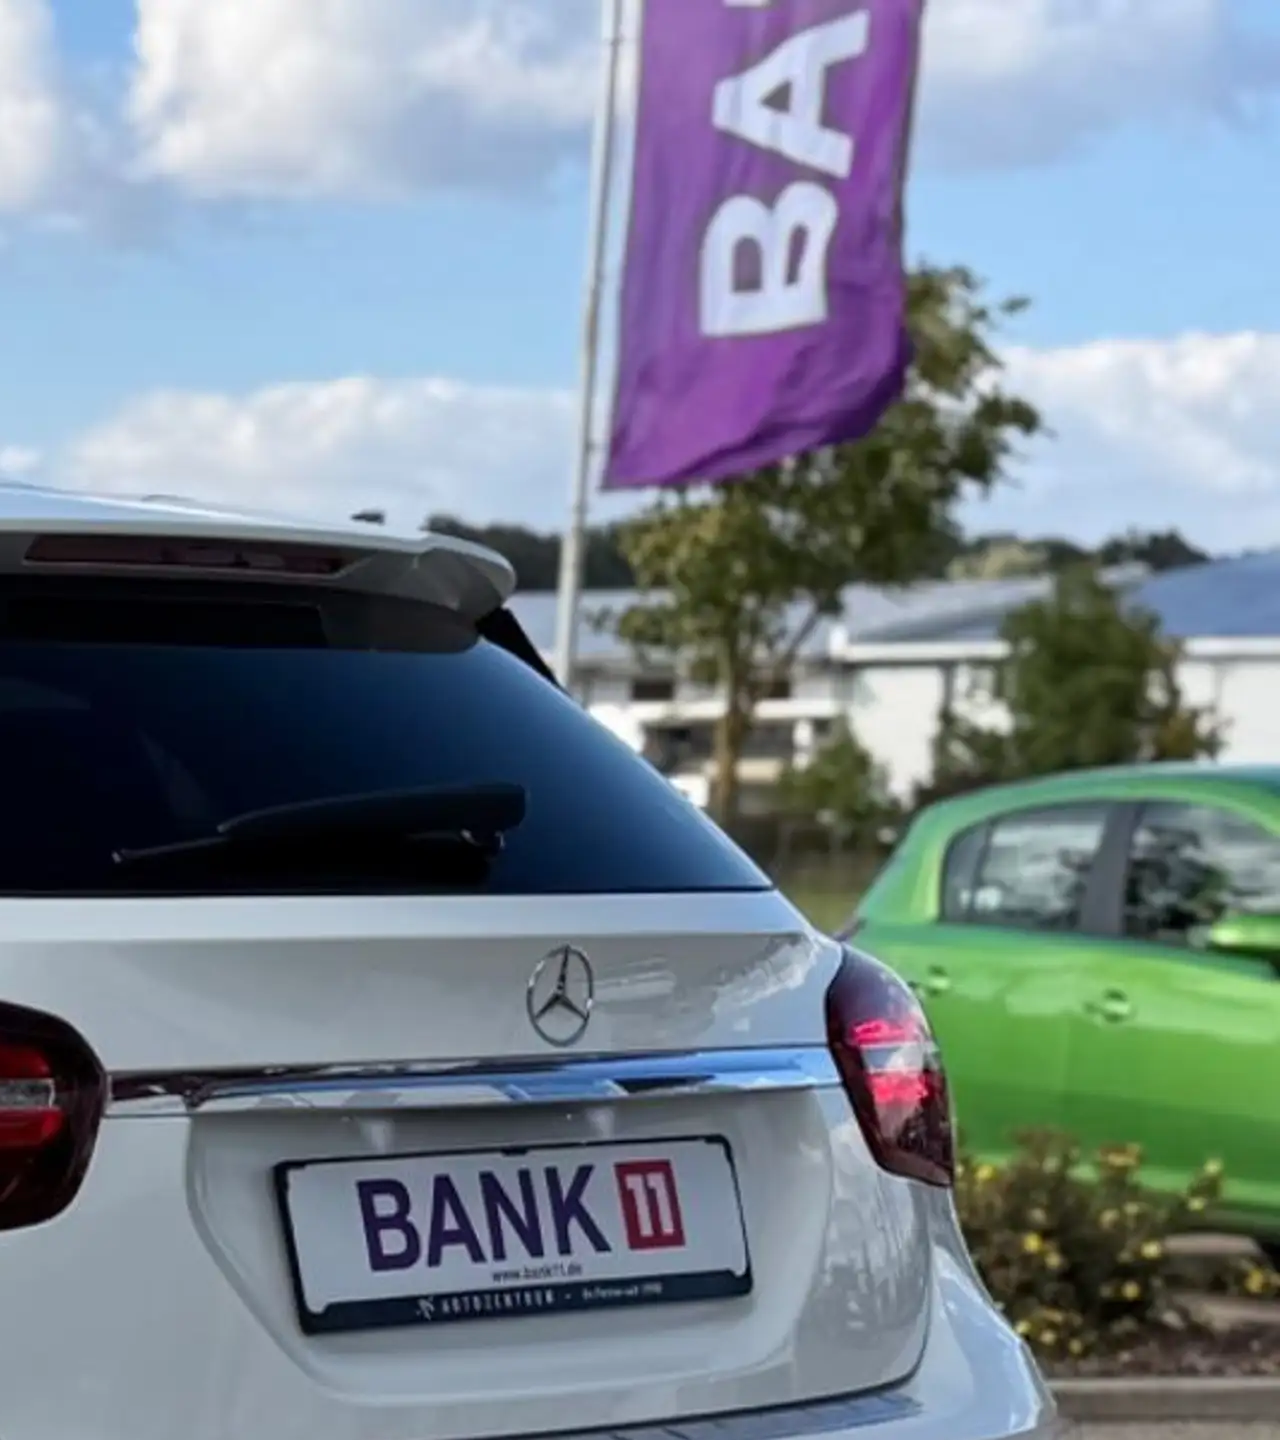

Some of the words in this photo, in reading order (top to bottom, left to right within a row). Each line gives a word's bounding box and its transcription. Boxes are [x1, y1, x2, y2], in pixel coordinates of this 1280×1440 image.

[698, 0, 871, 337] BA
[355, 1163, 612, 1272] BANK
[624, 1170, 677, 1239] 11
